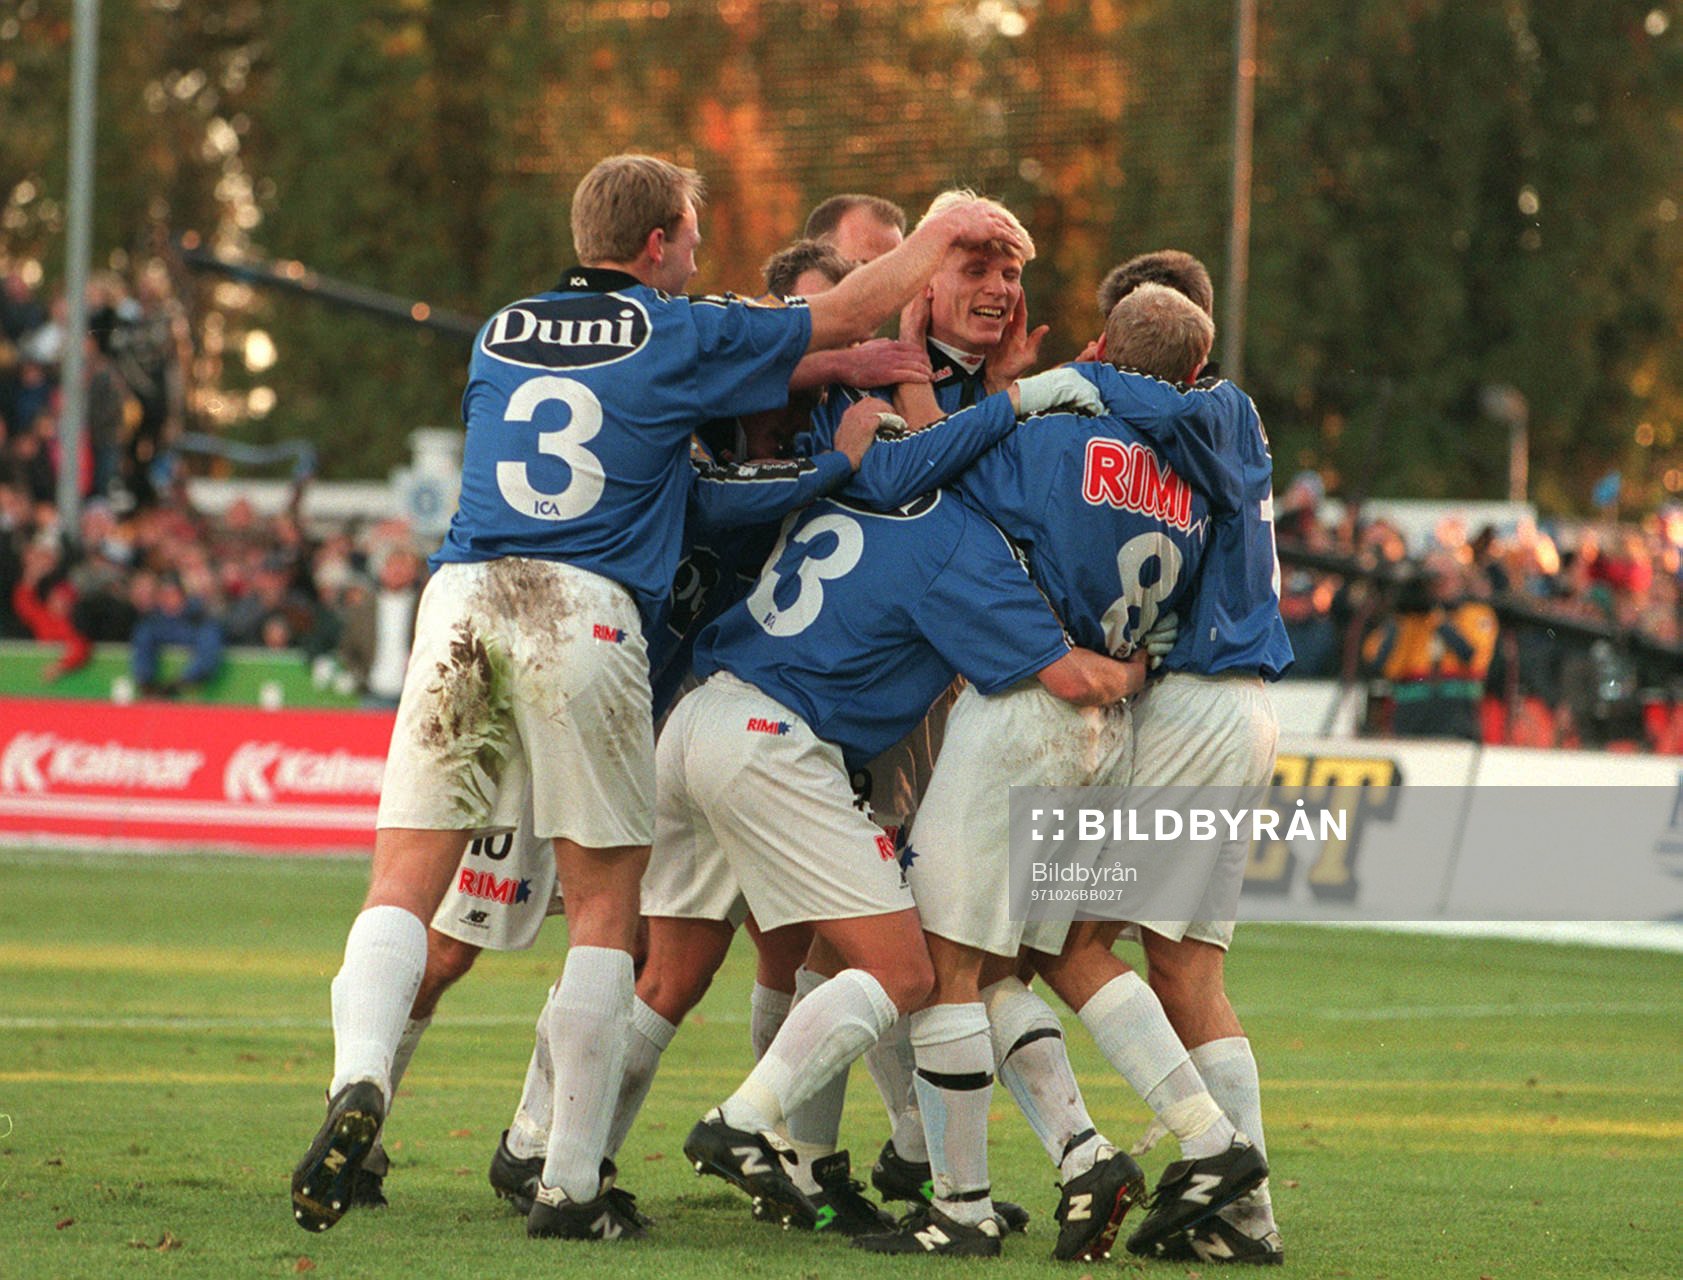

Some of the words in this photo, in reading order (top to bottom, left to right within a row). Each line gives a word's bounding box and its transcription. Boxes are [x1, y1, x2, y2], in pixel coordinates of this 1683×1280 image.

[570, 276, 588, 287] ICA
[487, 308, 636, 348] Duni
[496, 375, 606, 521] 3
[1082, 436, 1192, 532] RIMI
[534, 500, 560, 516] ICA
[1101, 531, 1183, 658] 8
[746, 717, 779, 735] RIMI
[471, 832, 513, 861] 10
[458, 866, 519, 905] RIMI
